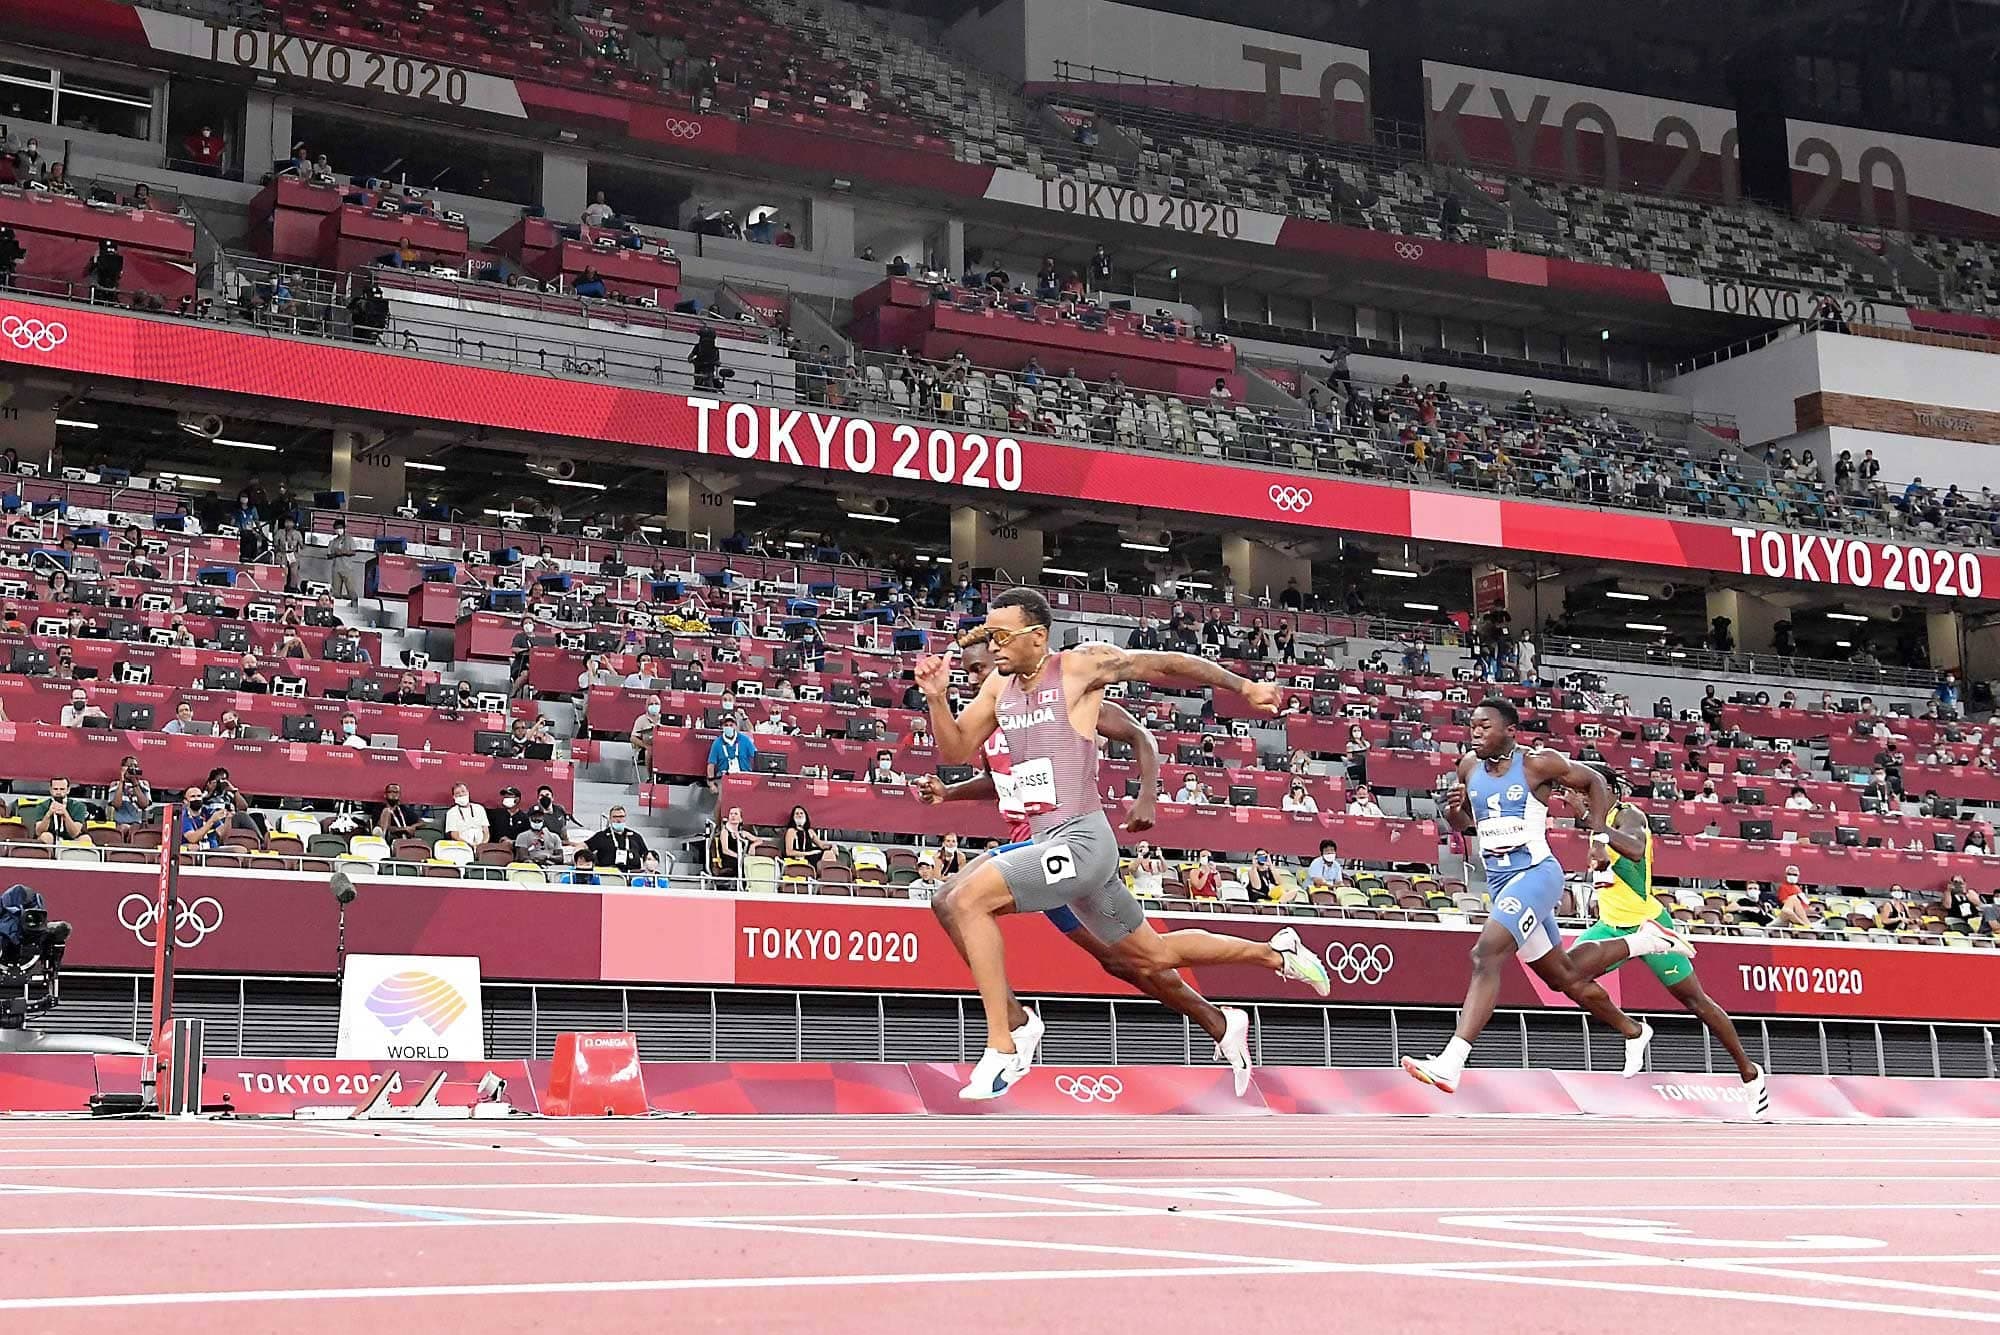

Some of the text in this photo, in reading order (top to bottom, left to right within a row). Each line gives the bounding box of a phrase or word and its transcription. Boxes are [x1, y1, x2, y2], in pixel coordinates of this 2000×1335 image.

[204, 20, 467, 105] TOKYO 2020
[1036, 174, 1239, 239] TOKYO 2020
[1704, 278, 1875, 323] TOKYO 220
[687, 397, 1023, 491] TOKYO 2020
[365, 453, 391, 468] 110
[701, 493, 723, 507] 110
[999, 526, 1018, 540] 108
[1731, 527, 1983, 598] TOKYO 2020
[999, 707, 1056, 731] CANADA
[1046, 855, 1070, 875] 6
[1522, 915, 1535, 932] 8
[743, 927, 918, 963] TOKYO 2020
[1738, 965, 1863, 995] TOKYO 2020
[387, 1046, 449, 1059] WORLD
[594, 1038, 629, 1047] OMEGA
[238, 1071, 331, 1095] TOKYO
[1651, 1084, 1717, 1102] TOKYO
